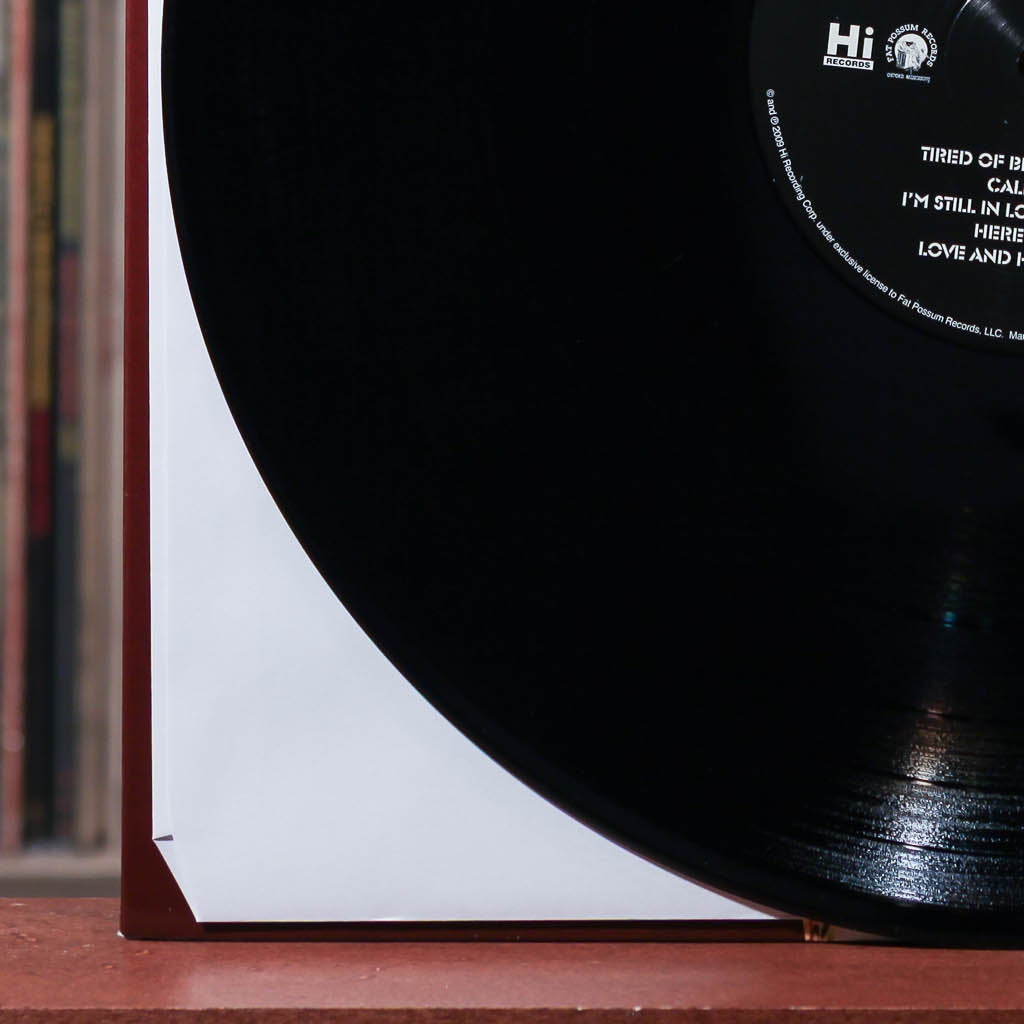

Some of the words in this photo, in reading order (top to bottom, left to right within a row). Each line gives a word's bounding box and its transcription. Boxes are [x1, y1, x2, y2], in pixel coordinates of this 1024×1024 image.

[827, 22, 875, 59] Hi
[888, 24, 919, 43] POSSUM
[921, 28, 938, 67] RECORDS
[825, 58, 872, 69] RECORDS
[767, 99, 778, 115] and
[772, 125, 785, 147] 2009
[779, 148, 789, 158] Hi
[921, 146, 973, 166] TIRED
[978, 152, 1005, 169] OF
[783, 159, 805, 201] Recording
[802, 200, 817, 222] Corp.
[902, 192, 930, 209] I'M
[934, 195, 976, 214] STILL
[981, 200, 1001, 217] IN
[816, 221, 835, 243] under
[974, 223, 1024, 243] HERE
[833, 242, 863, 273] exclusive
[918, 241, 966, 261] LOVE
[969, 247, 1012, 265] AND
[862, 269, 889, 293] license
[888, 289, 897, 299] to
[897, 294, 912, 308] Fat
[911, 302, 944, 323] Possum
